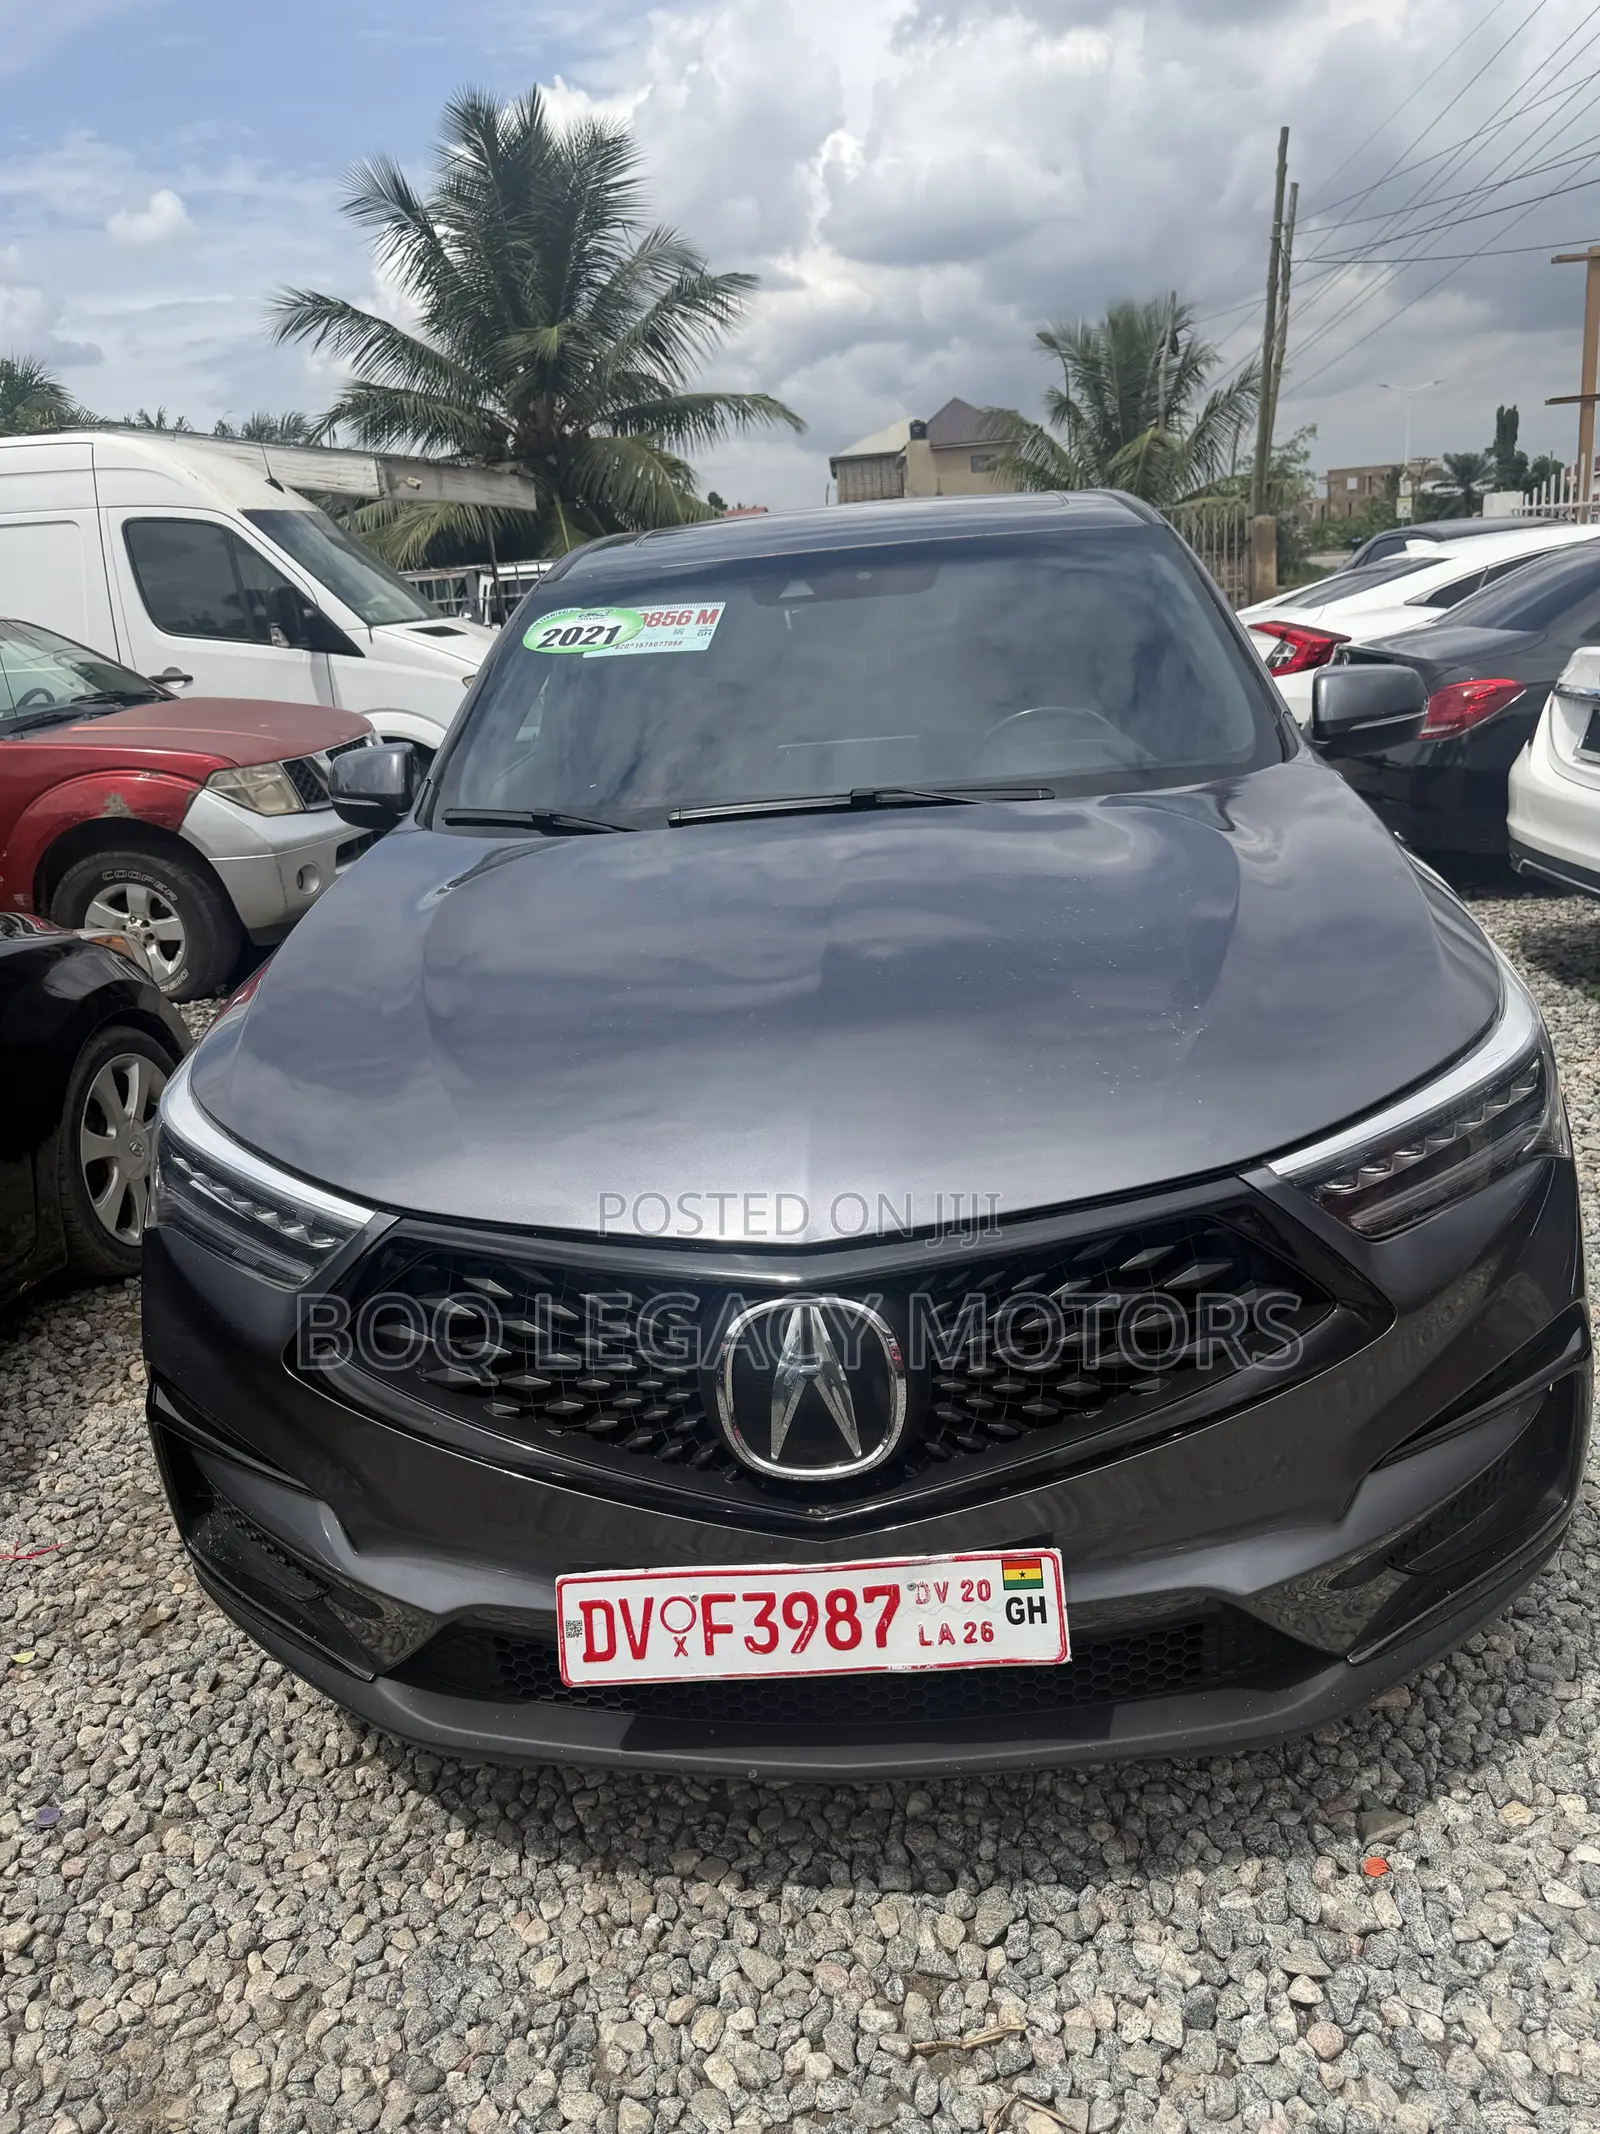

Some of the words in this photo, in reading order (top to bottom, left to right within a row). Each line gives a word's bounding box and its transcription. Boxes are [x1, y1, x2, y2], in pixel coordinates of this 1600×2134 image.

[696, 609, 719, 625] M
[536, 625, 622, 649] 2021
[102, 870, 178, 901] COOPER
[960, 1579, 991, 1602] 20
[1005, 1595, 1048, 1625] GH
